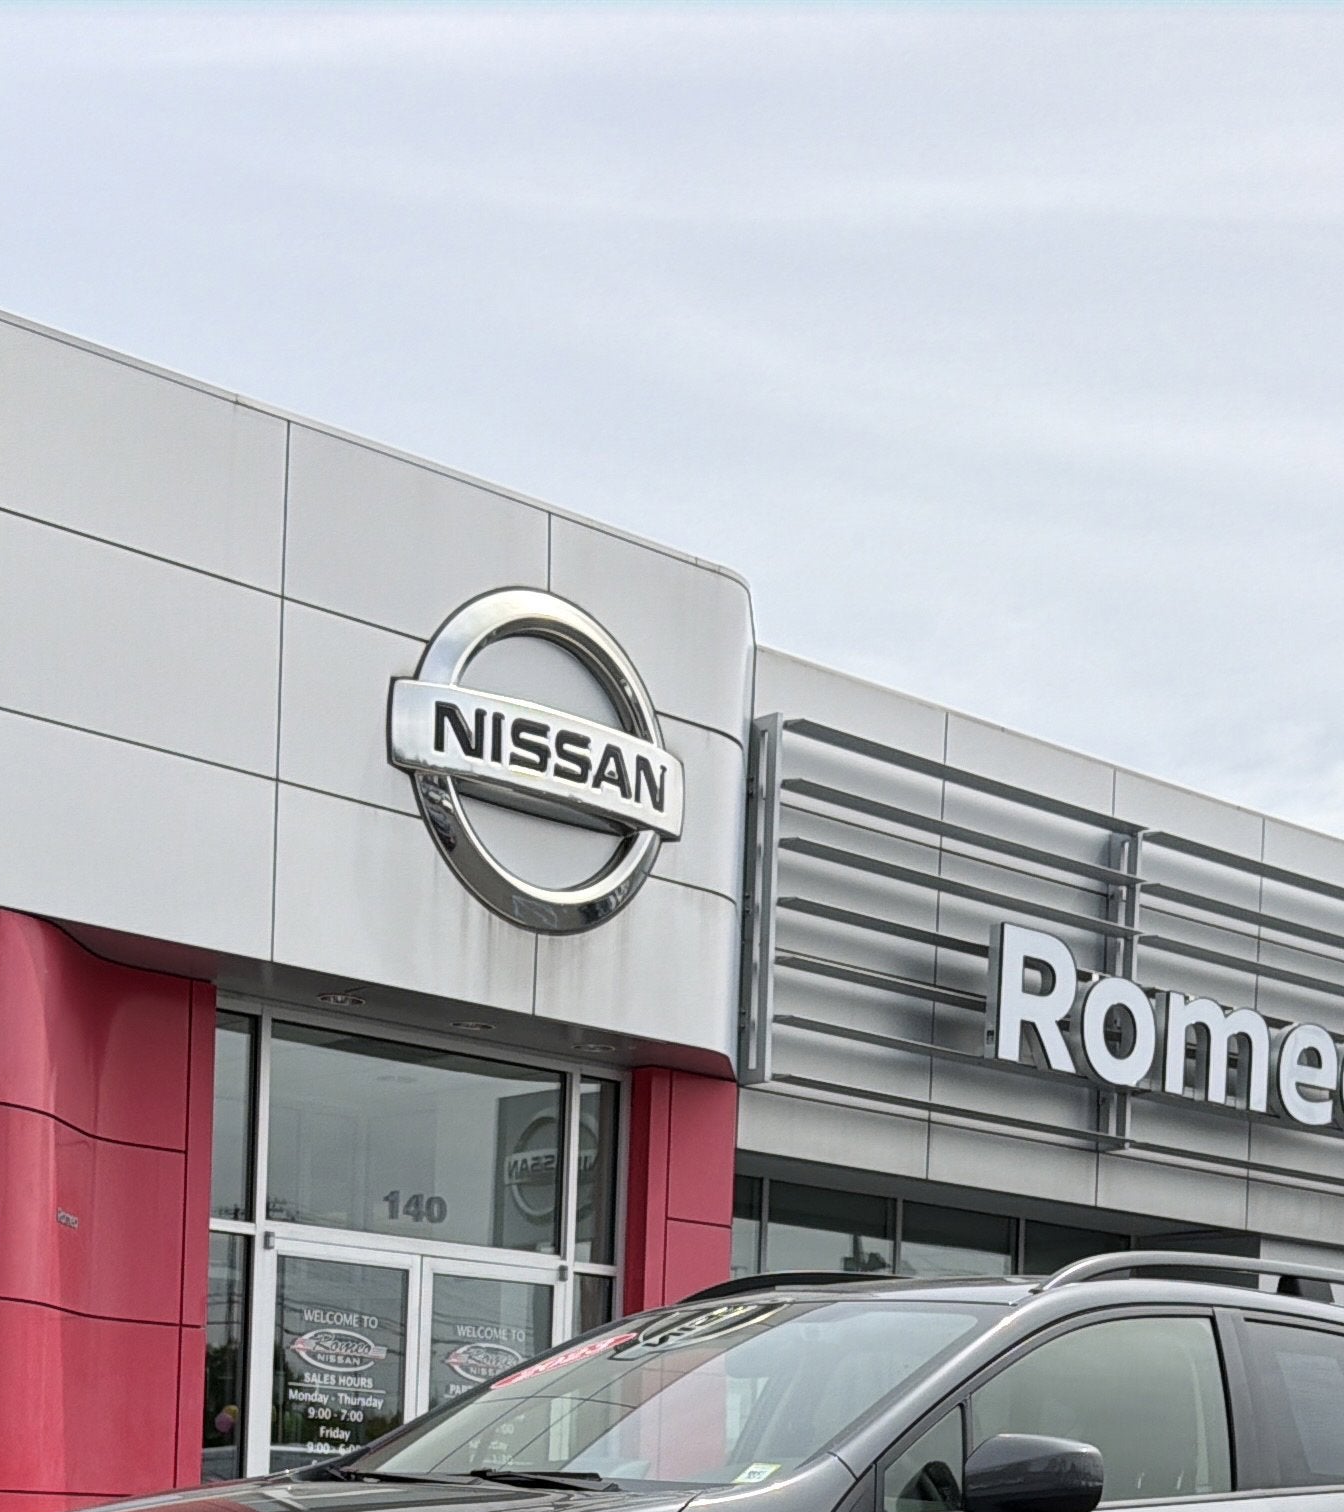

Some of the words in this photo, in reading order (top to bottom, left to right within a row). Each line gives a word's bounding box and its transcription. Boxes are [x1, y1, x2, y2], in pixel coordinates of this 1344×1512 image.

[433, 700, 668, 813] NISSAN
[383, 1190, 447, 1223] 140
[304, 1309, 359, 1328] WELCOME
[361, 1315, 378, 1329] TO
[456, 1325, 508, 1340] WELCOME
[511, 1329, 525, 1342] TO
[313, 1331, 372, 1354] Romeo
[317, 1353, 361, 1366] NISSAN
[469, 1366, 502, 1377] NISS
[304, 1372, 336, 1386] SALES
[338, 1376, 373, 1389] HOURS
[288, 1388, 329, 1405] Monday
[337, 1393, 384, 1410] Thursday
[307, 1408, 331, 1420] 9:00
[340, 1411, 364, 1422] 7:00
[319, 1426, 351, 1441] Friday
